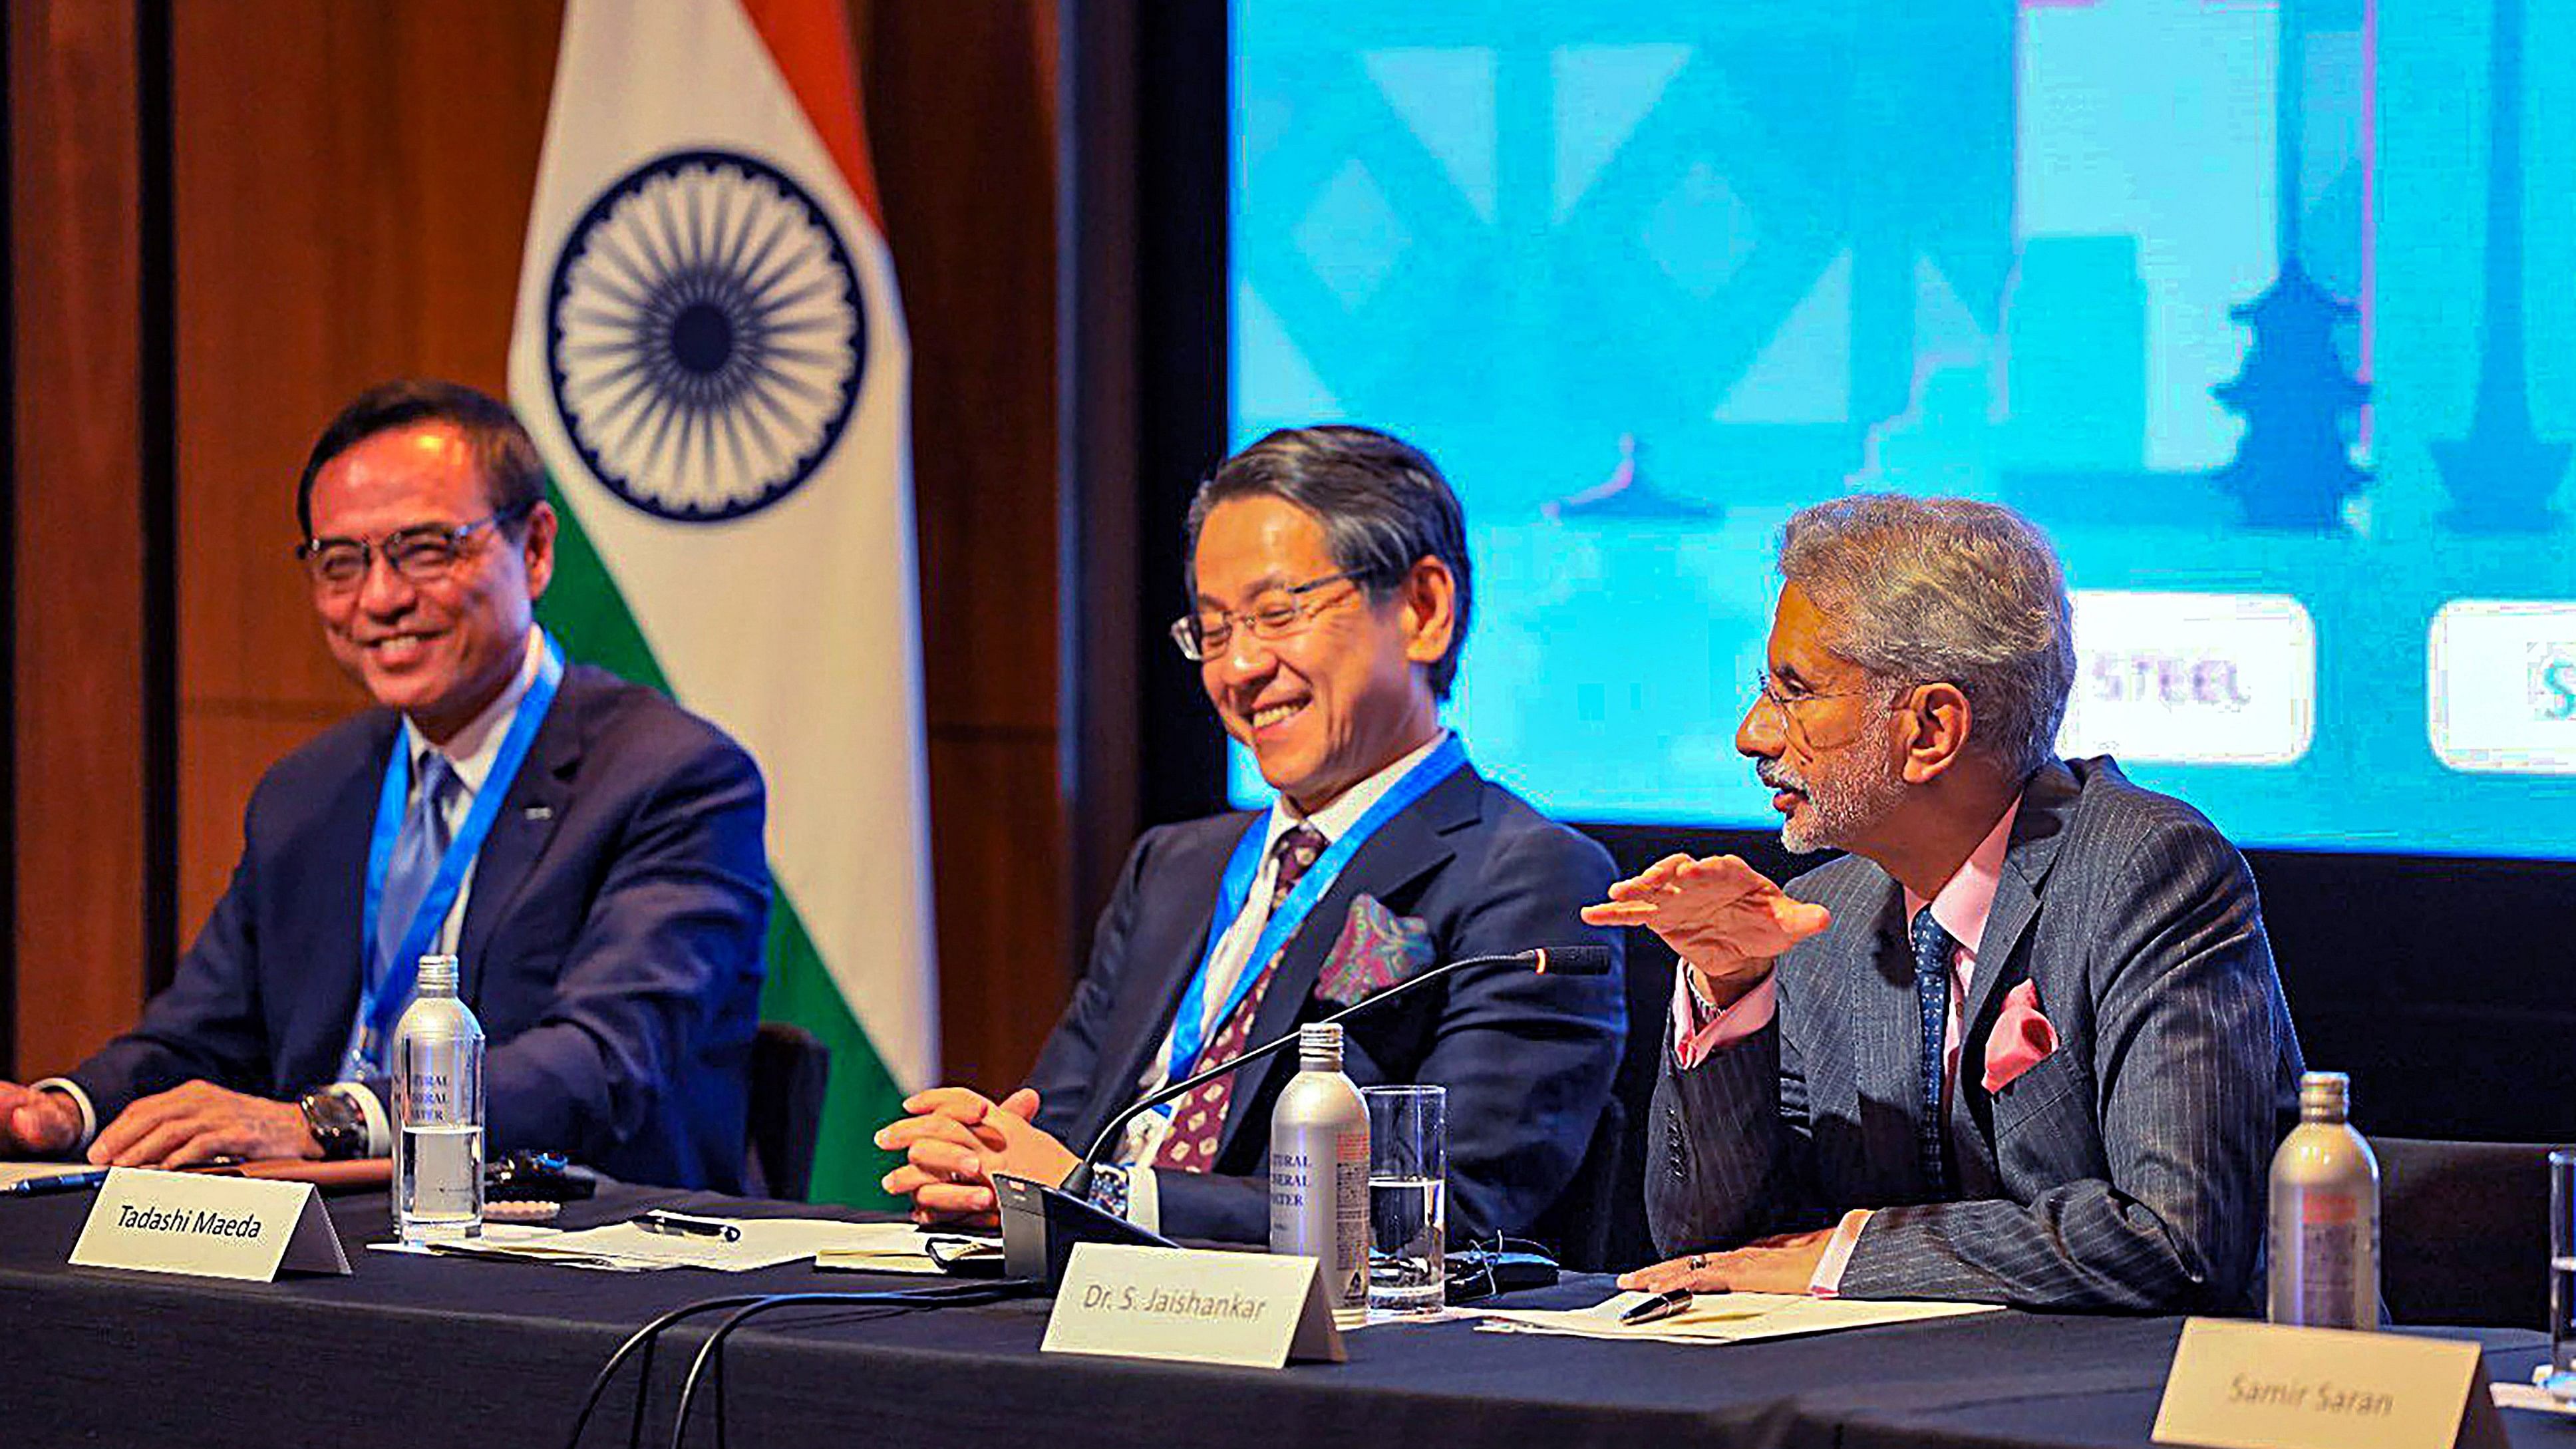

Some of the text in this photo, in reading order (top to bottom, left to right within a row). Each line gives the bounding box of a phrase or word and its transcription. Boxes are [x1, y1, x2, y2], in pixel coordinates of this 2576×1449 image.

[1273, 1154, 1312, 1168] TURAL
[118, 1205, 261, 1238] Tadashi Maeda
[1084, 1285, 1266, 1321] Dr. S. Jaishankar
[2229, 1372, 2395, 1416] Samir Saran
